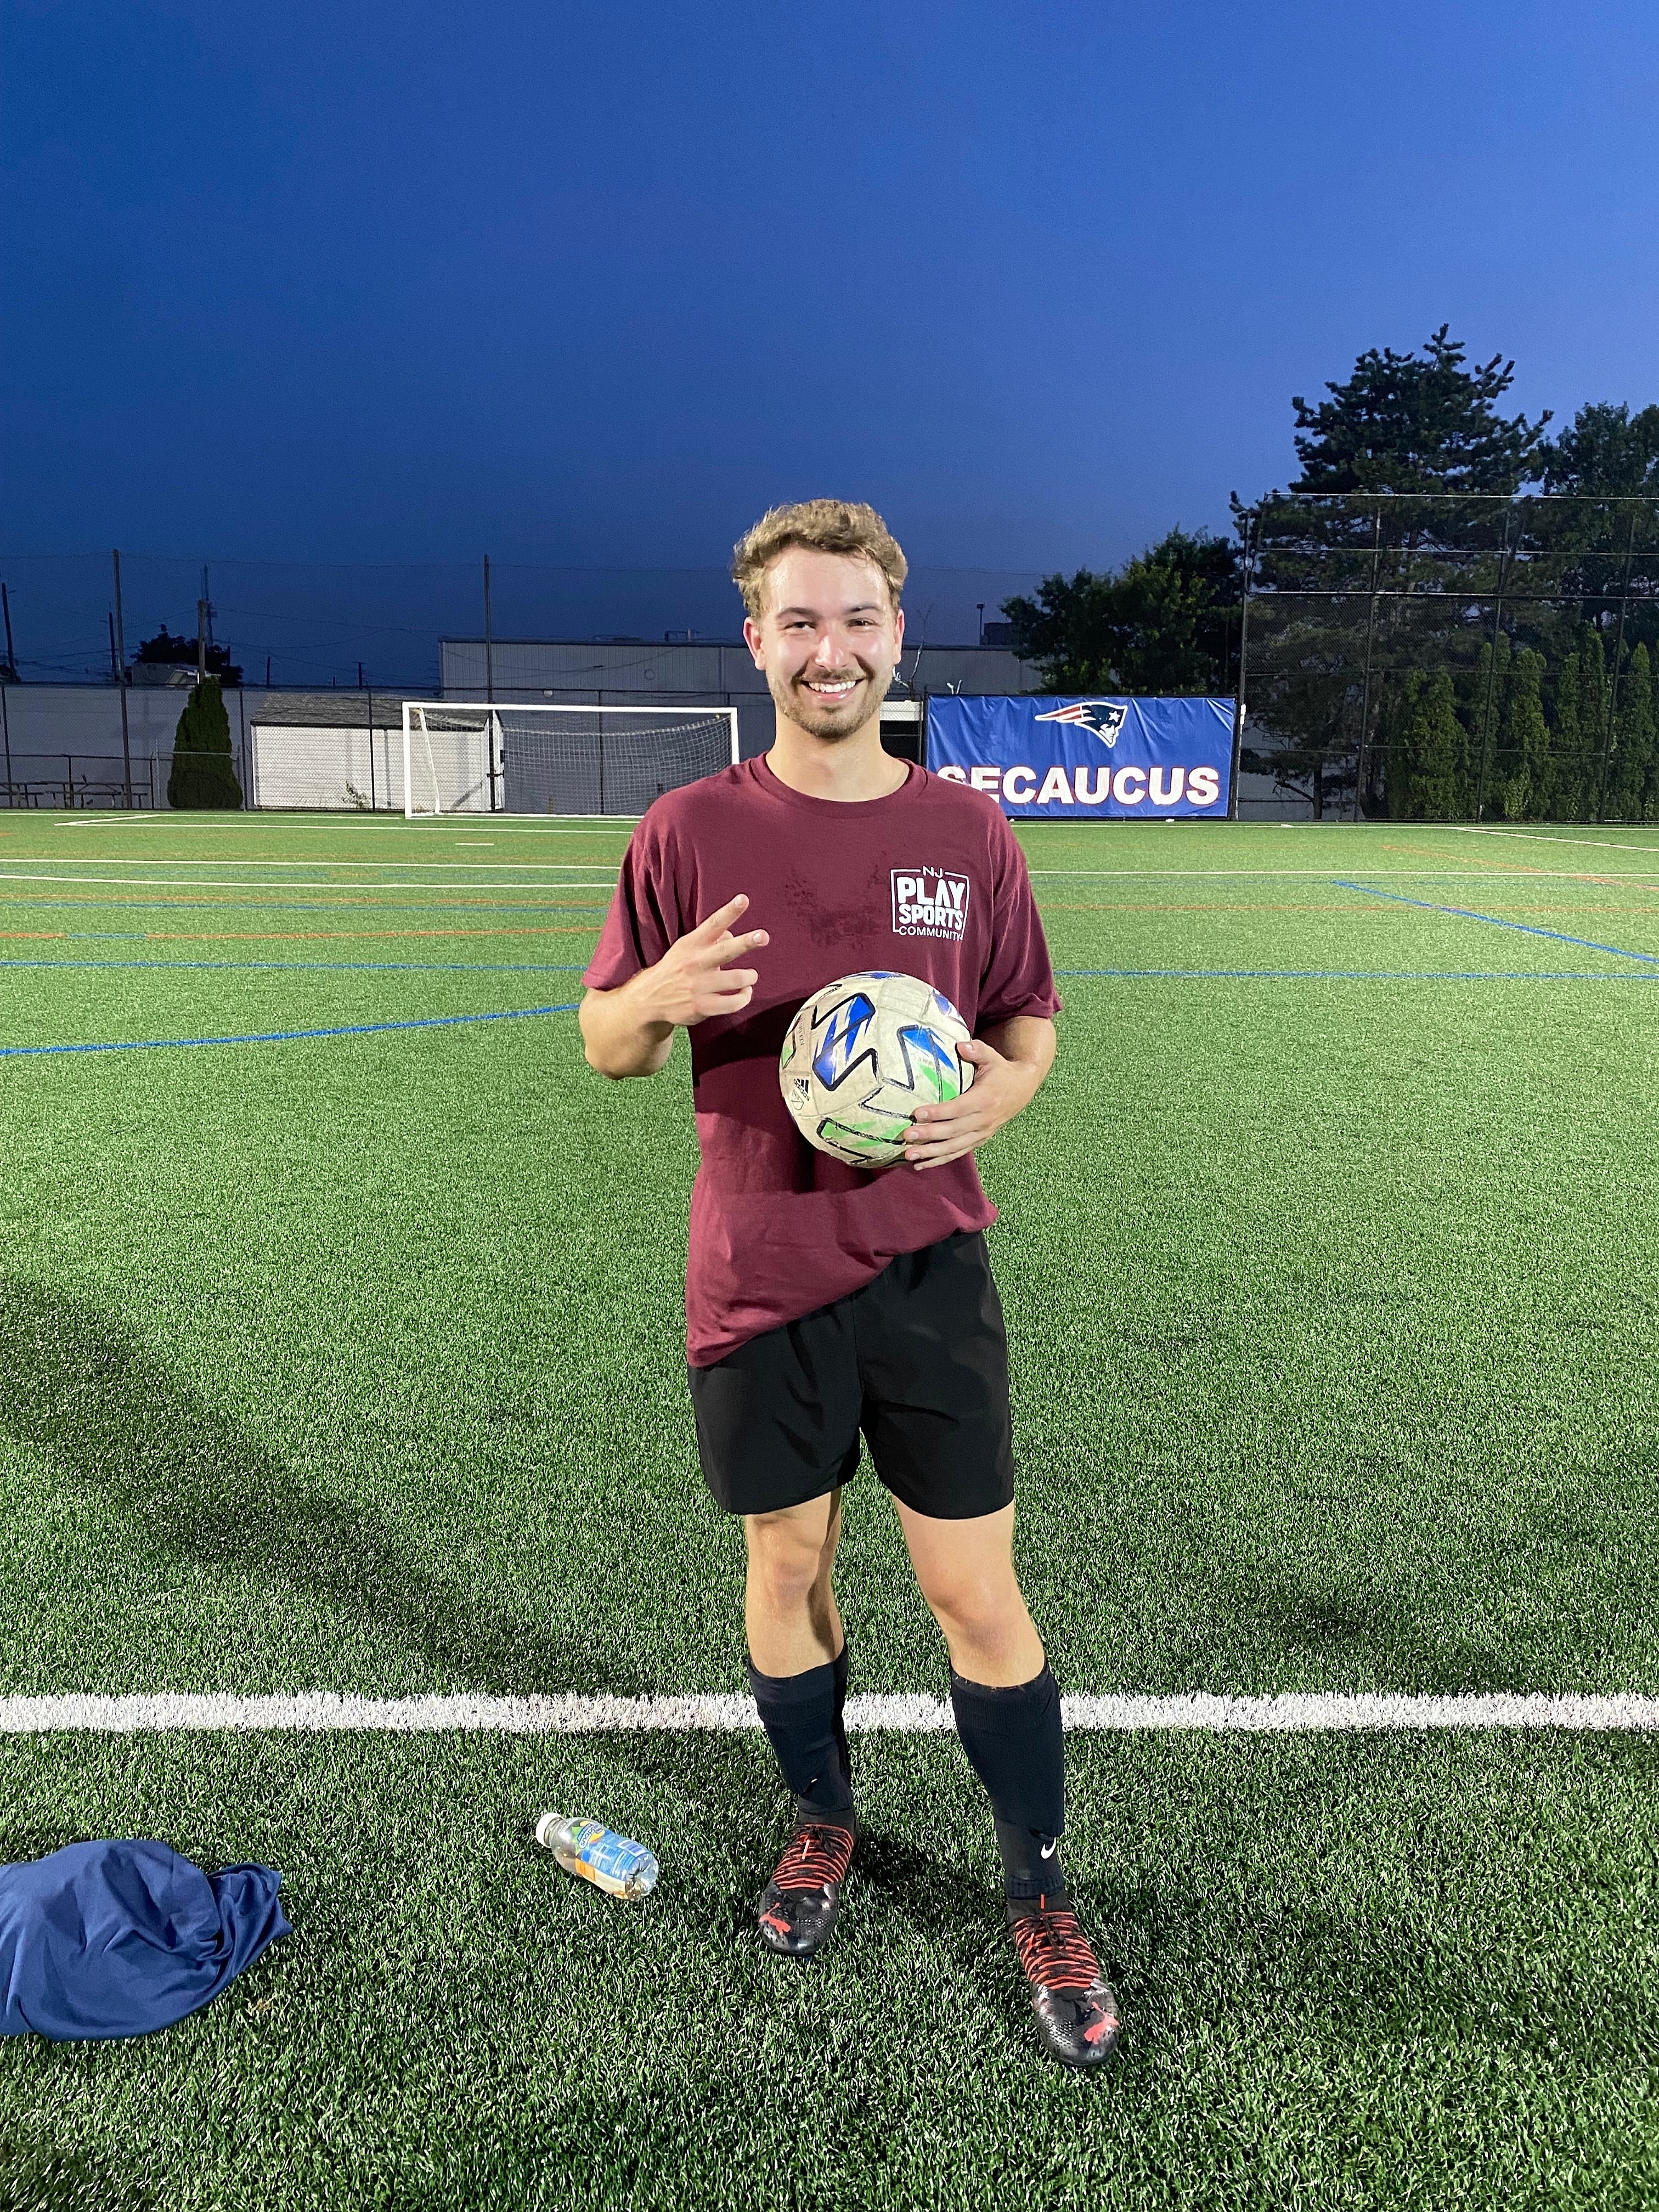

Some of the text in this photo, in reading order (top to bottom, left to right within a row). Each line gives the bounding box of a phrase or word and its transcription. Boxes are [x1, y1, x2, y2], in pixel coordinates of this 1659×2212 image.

[922, 866, 943, 878] NJ
[896, 877, 966, 910] PLAY
[898, 904, 963, 930] SPORTS
[899, 926, 961, 941] COMMUNITY
[793, 1079, 810, 1101] adidas
